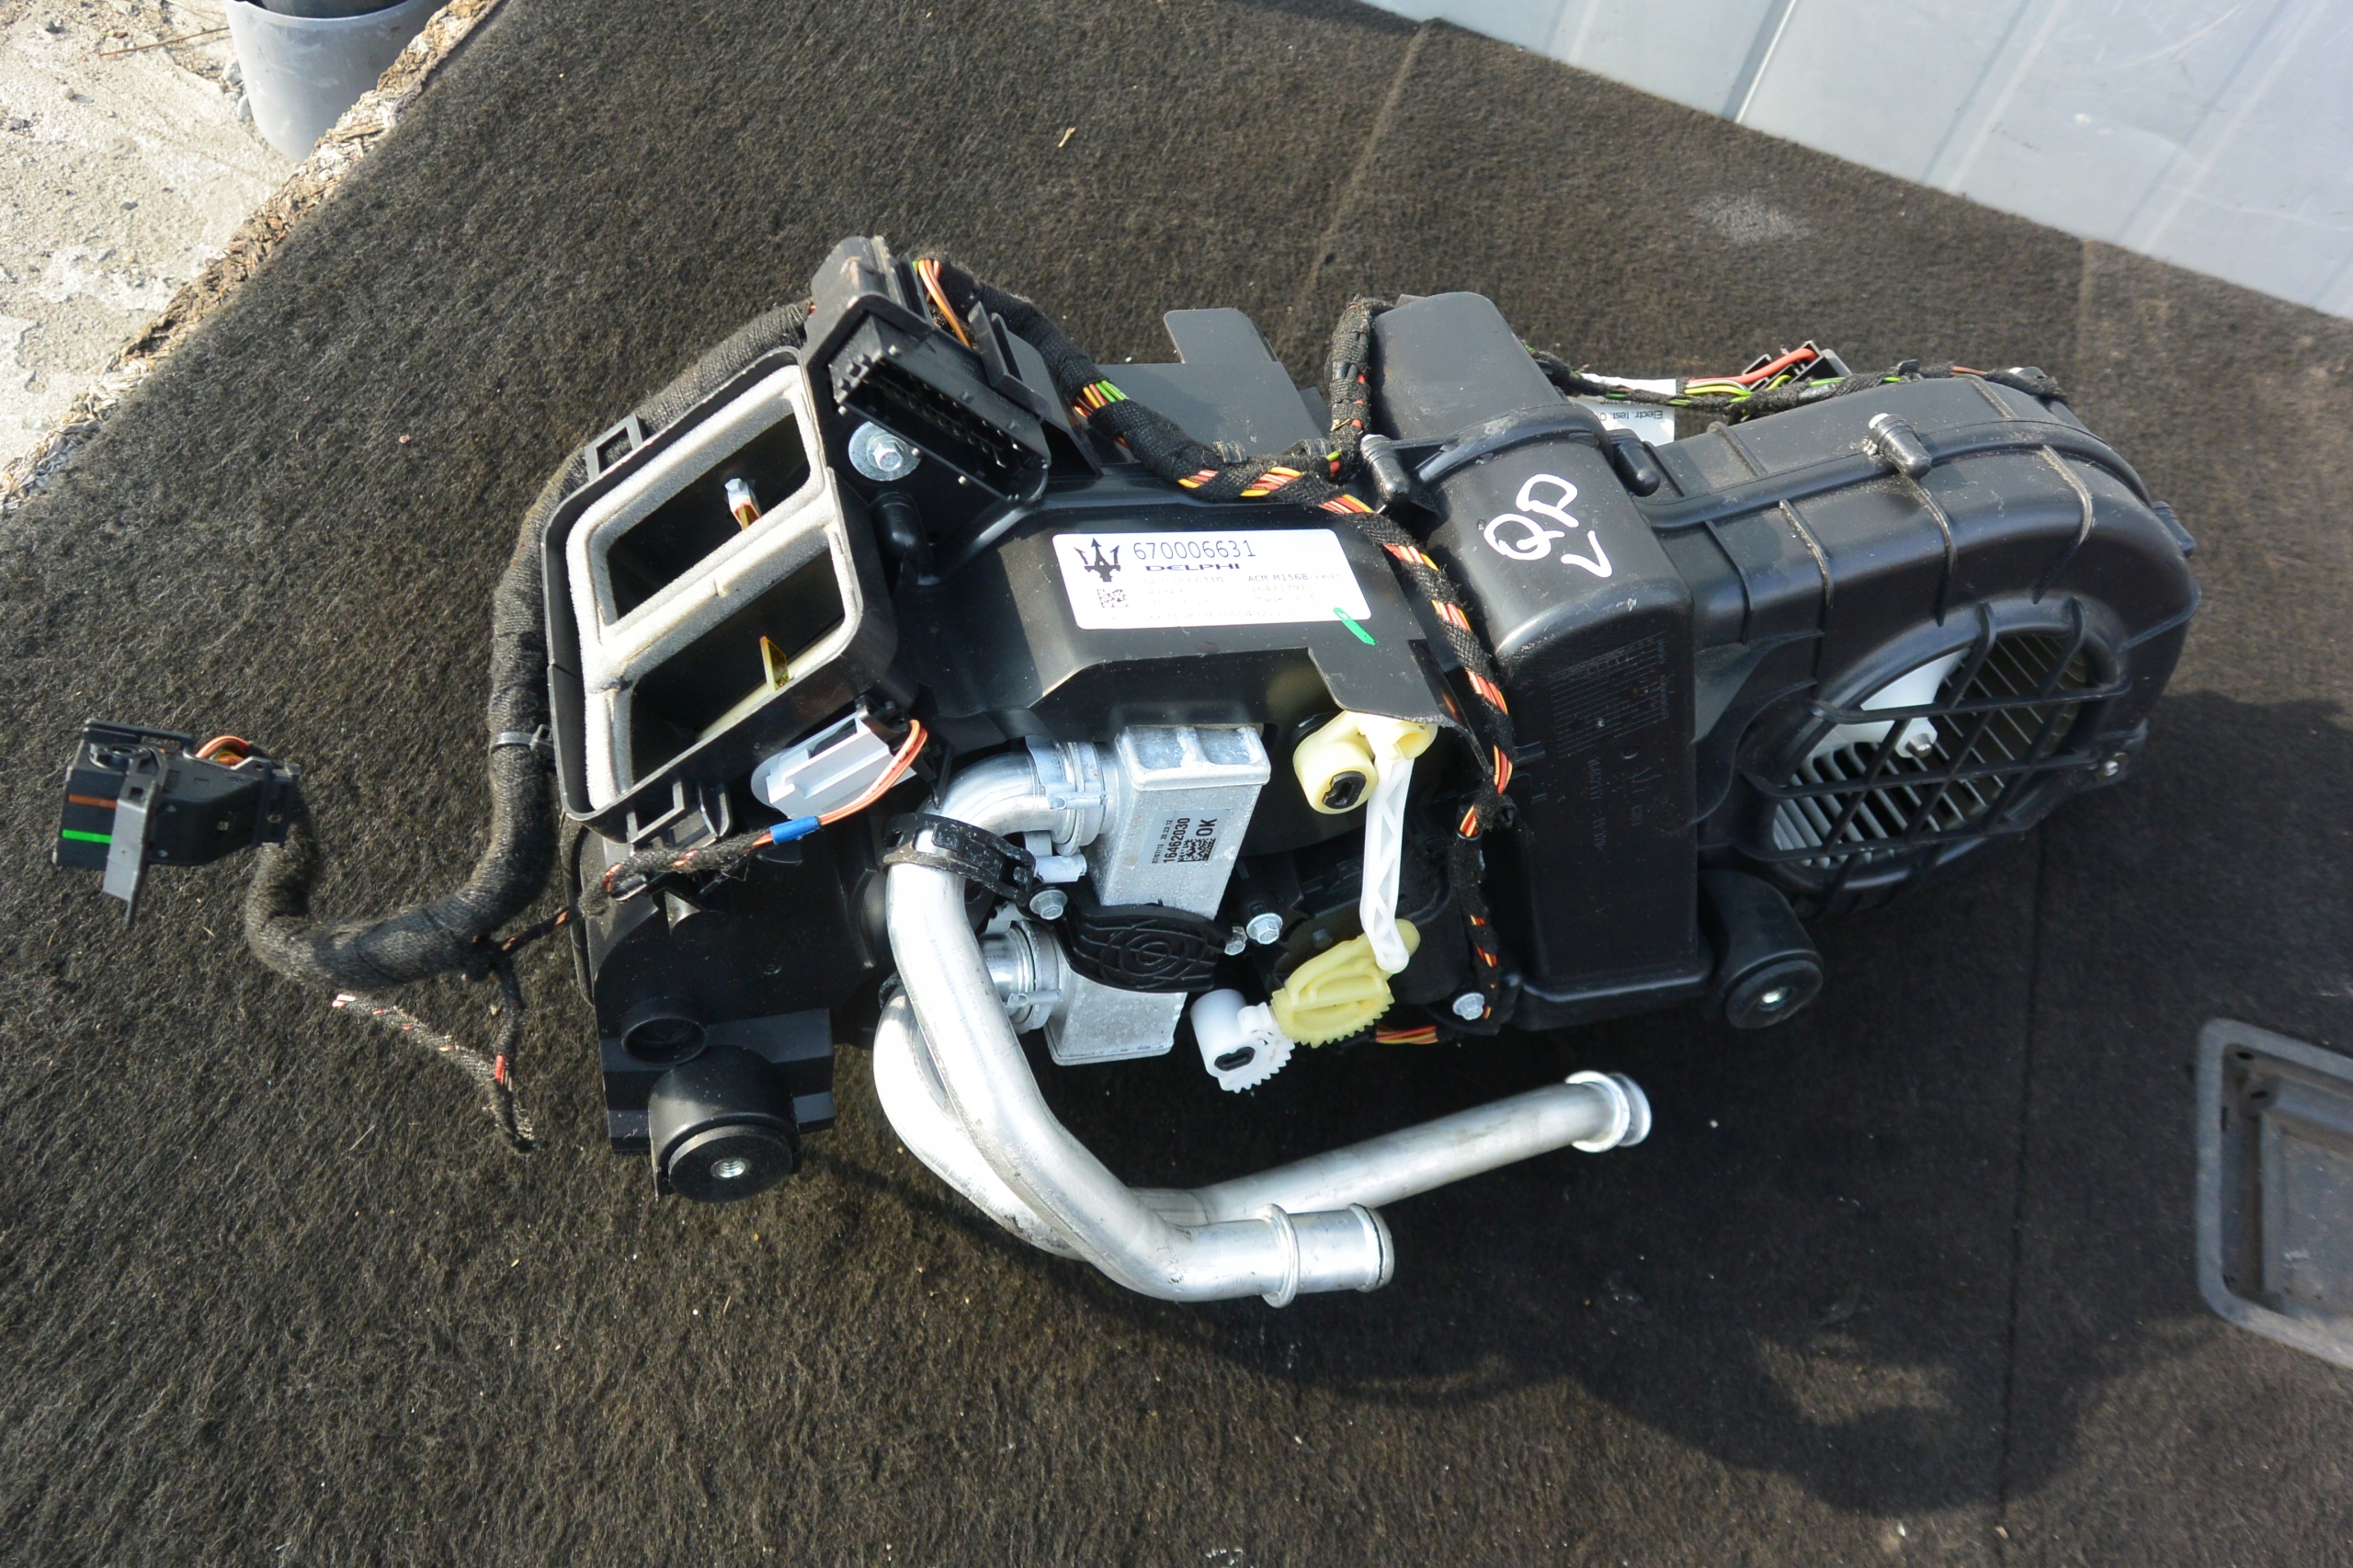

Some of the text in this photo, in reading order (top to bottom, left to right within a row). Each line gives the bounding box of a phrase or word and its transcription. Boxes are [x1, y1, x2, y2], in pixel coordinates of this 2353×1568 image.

[1632, 410, 1663, 420] Electr.
[1132, 540, 1256, 560] 670006631
[1145, 563, 1240, 572] DELPHI
[1273, 574, 1309, 582] M156B
[1196, 818, 1218, 836] OK
[1163, 817, 1191, 864] 16462030
